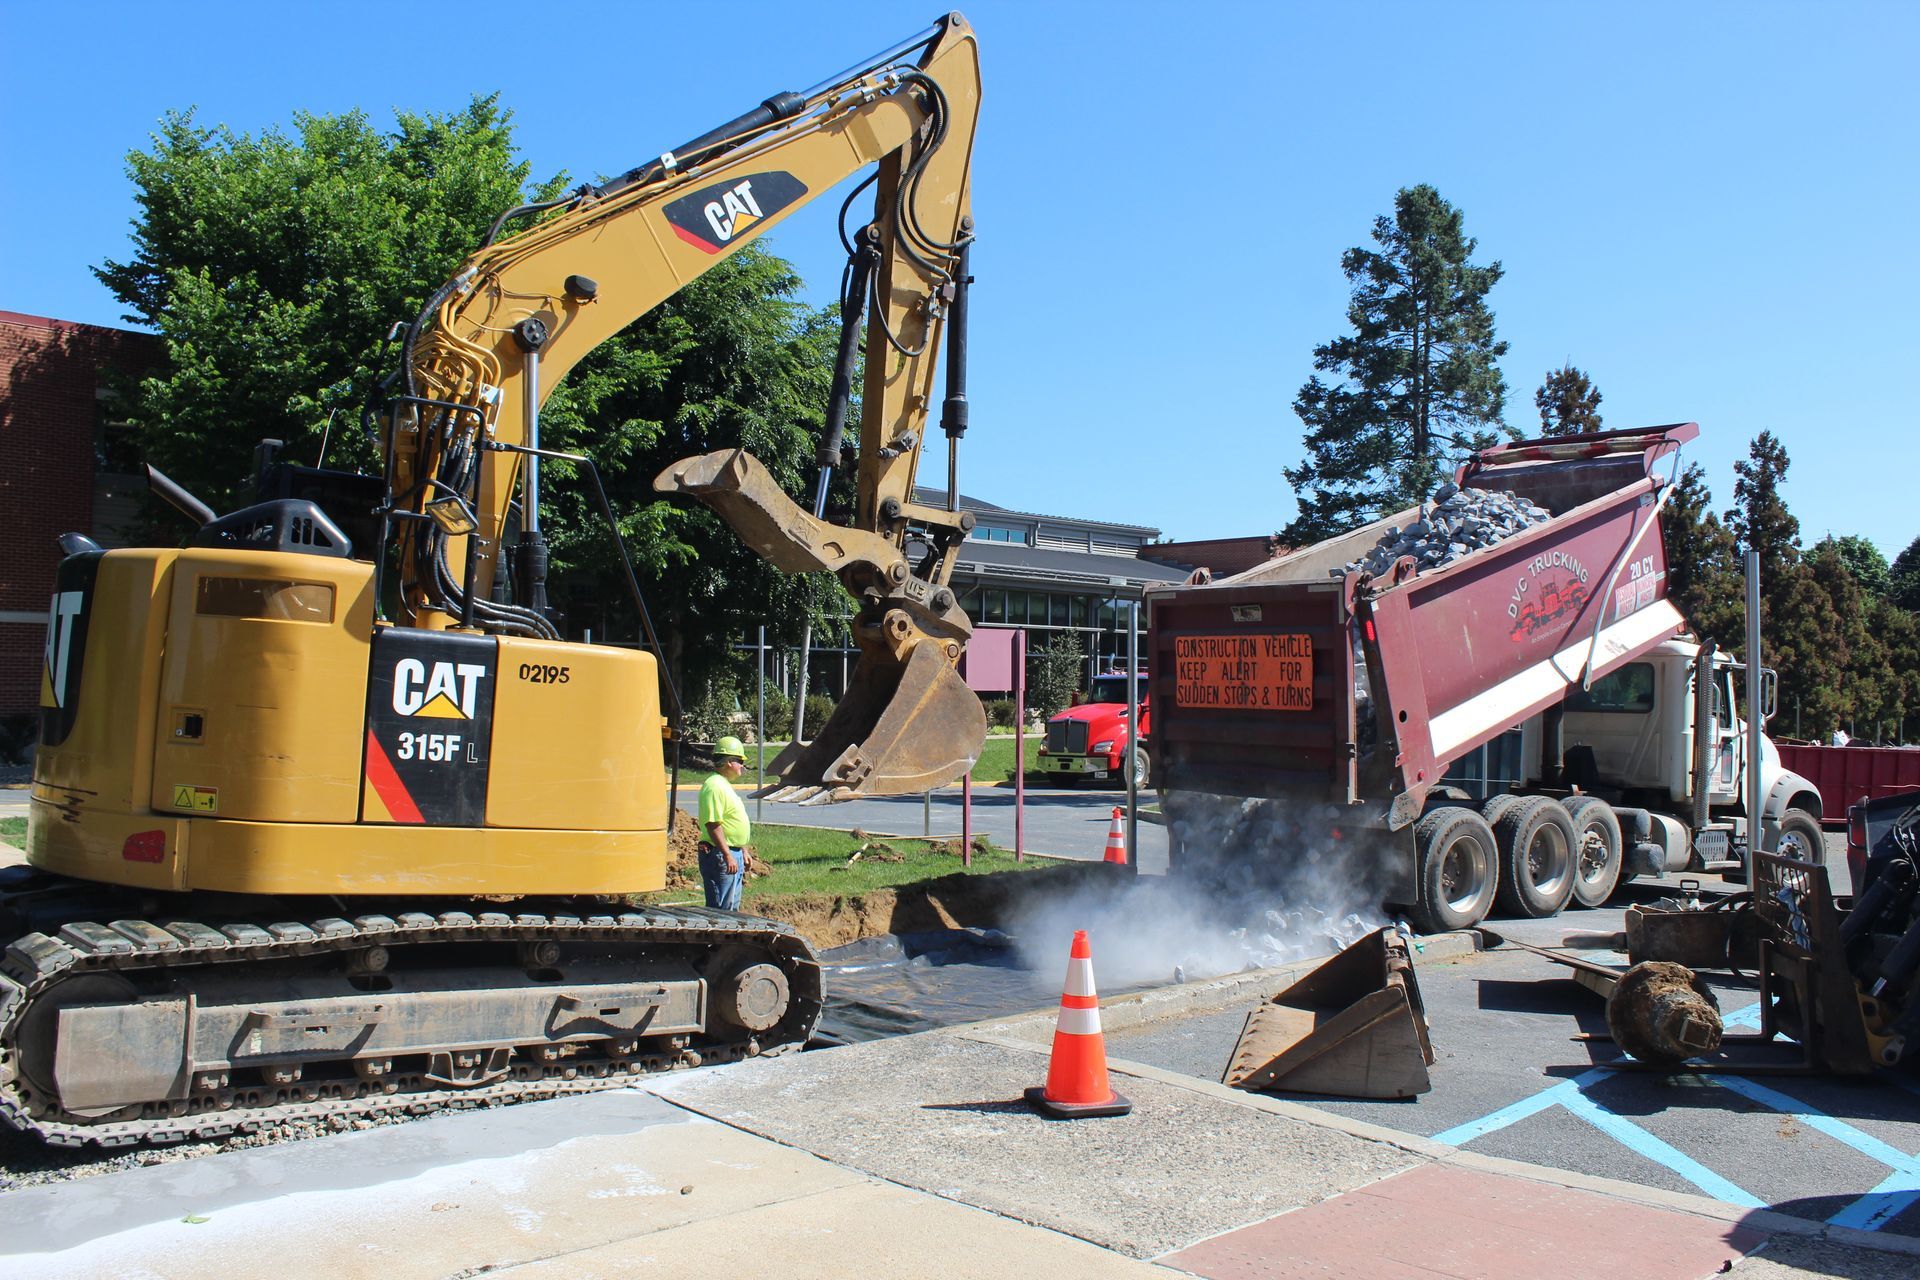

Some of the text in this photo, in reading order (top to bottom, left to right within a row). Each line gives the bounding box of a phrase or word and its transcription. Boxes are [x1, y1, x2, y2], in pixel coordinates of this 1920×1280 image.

[704, 180, 764, 241] CAT
[1630, 554, 1654, 580] 20 CY
[1507, 551, 1589, 618] DVC TRUCKING
[1177, 637, 1312, 658] CONSTRUCTION VEHICLE
[519, 663, 570, 684] 02195
[1180, 661, 1303, 682] KEEP ALERT FOR
[393, 658, 486, 720] CAT
[1177, 685, 1312, 707] SUDDEN STOPS & TURNS
[397, 732, 479, 764] 315F L
